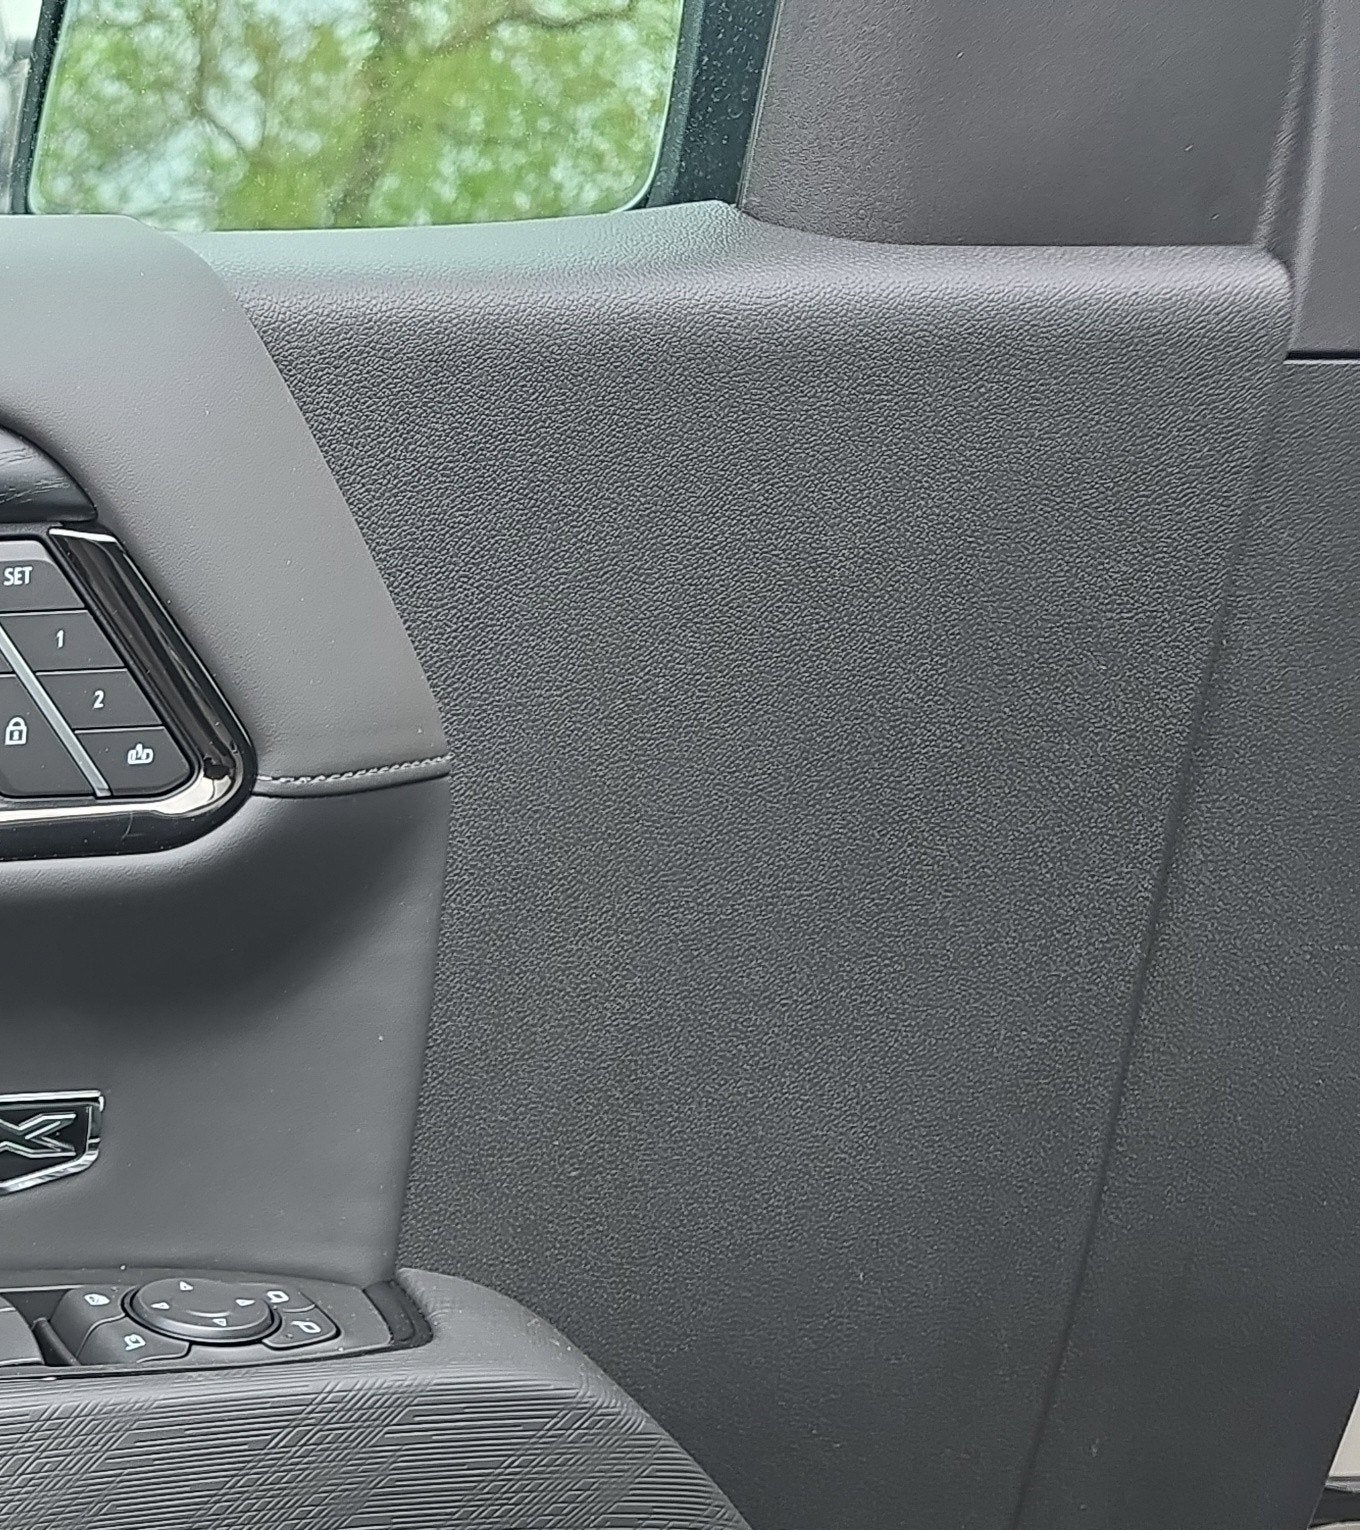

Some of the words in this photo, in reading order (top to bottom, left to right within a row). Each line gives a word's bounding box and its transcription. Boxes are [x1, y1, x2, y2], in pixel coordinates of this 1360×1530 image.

[3, 566, 33, 587] SET
[55, 629, 65, 649] 1
[93, 689, 106, 710] 2
